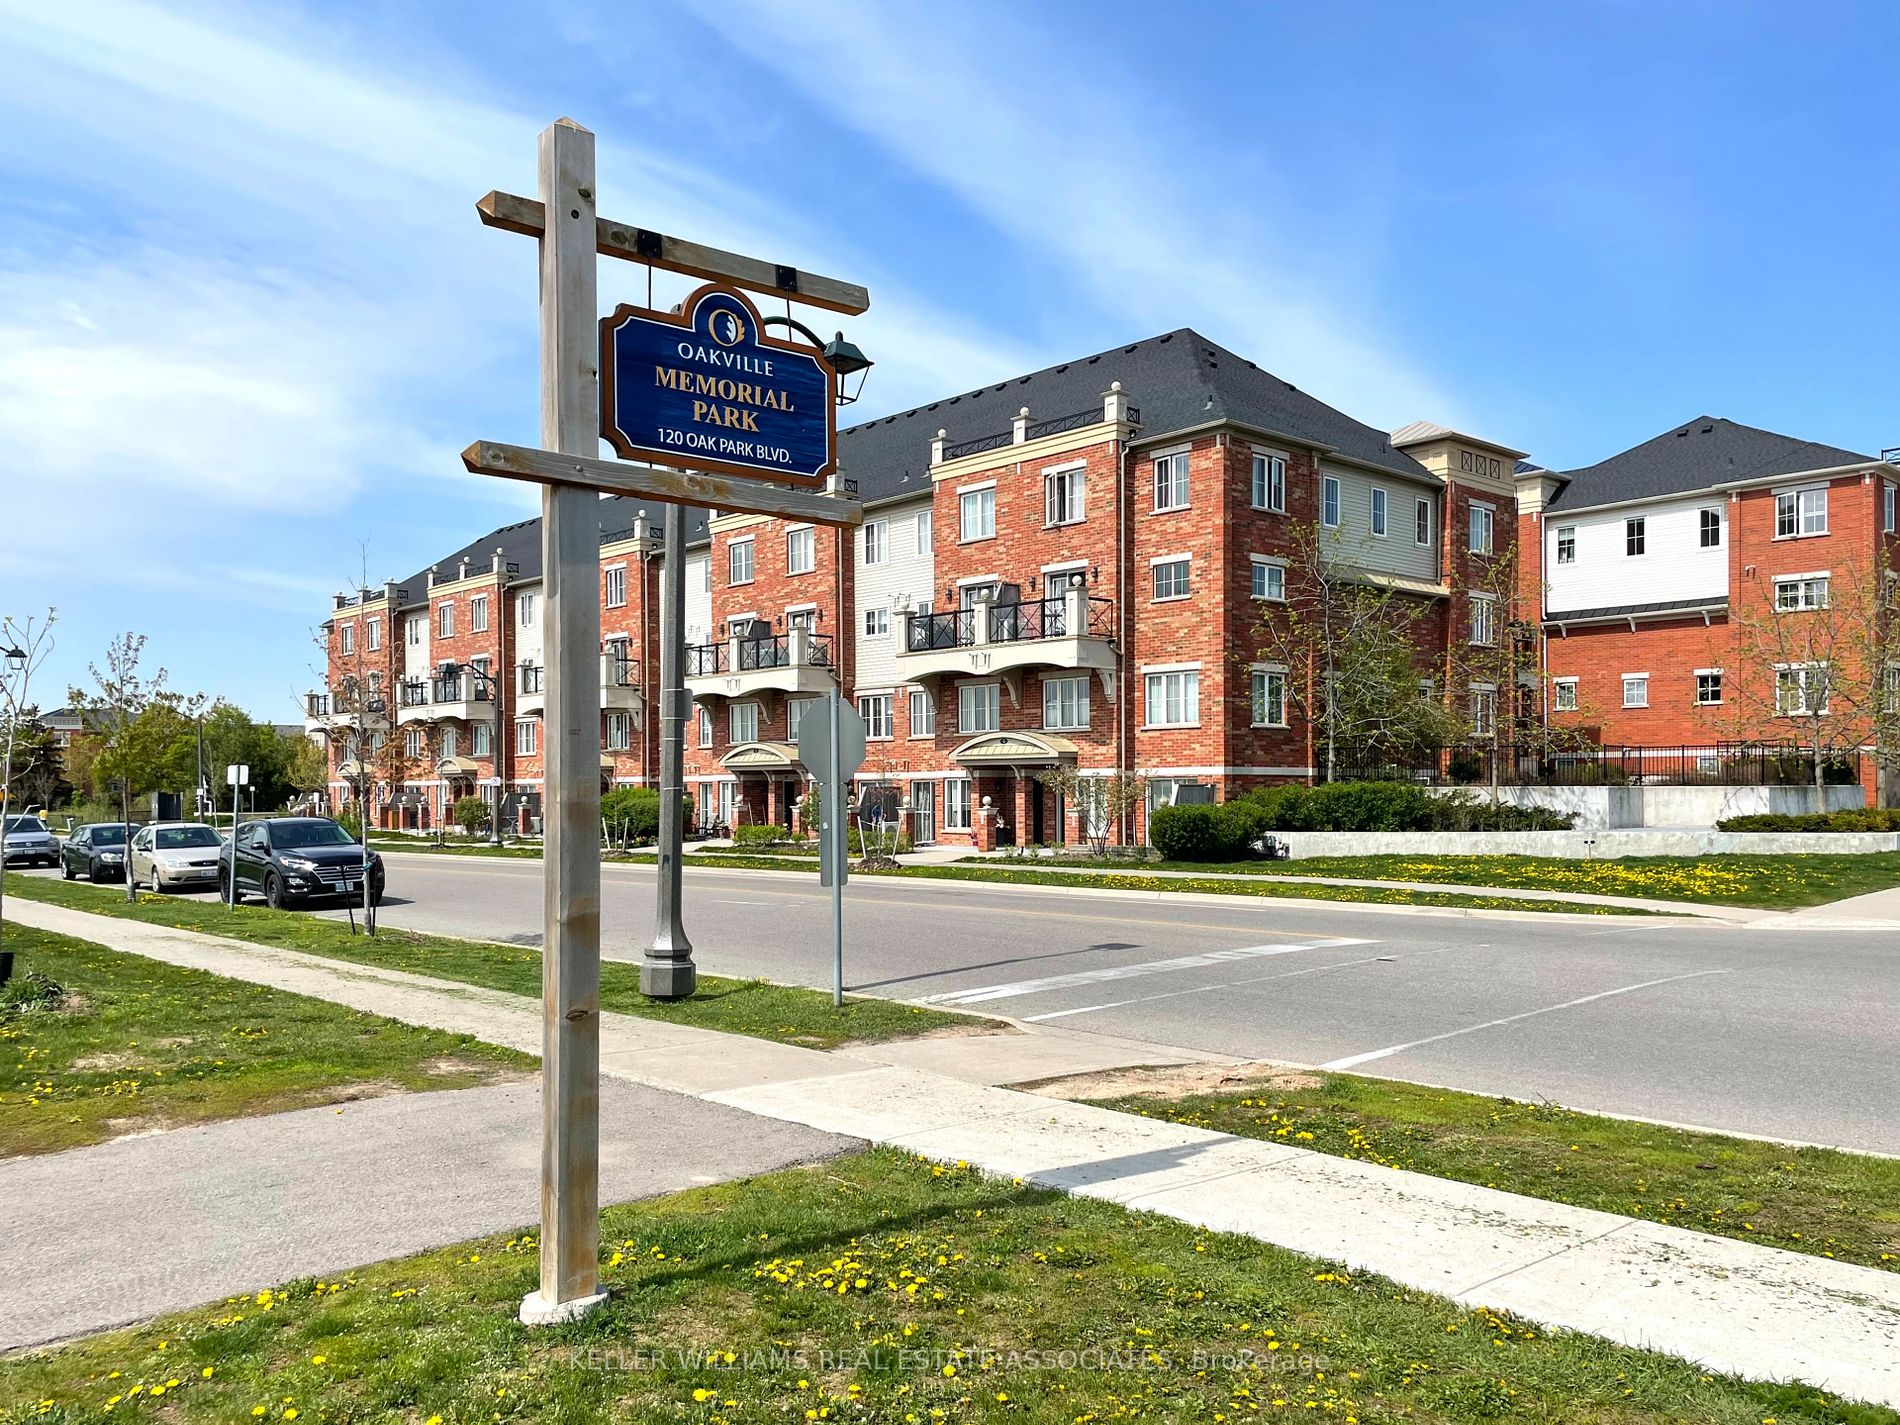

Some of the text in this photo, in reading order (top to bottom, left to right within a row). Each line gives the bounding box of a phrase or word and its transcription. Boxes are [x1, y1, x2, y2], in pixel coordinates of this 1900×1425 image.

[677, 342, 774, 376] OAKVILLE
[654, 365, 794, 412] MEMORIAL
[692, 400, 760, 433] PARK
[657, 428, 793, 464] 120 OAK PARK BLVD.
